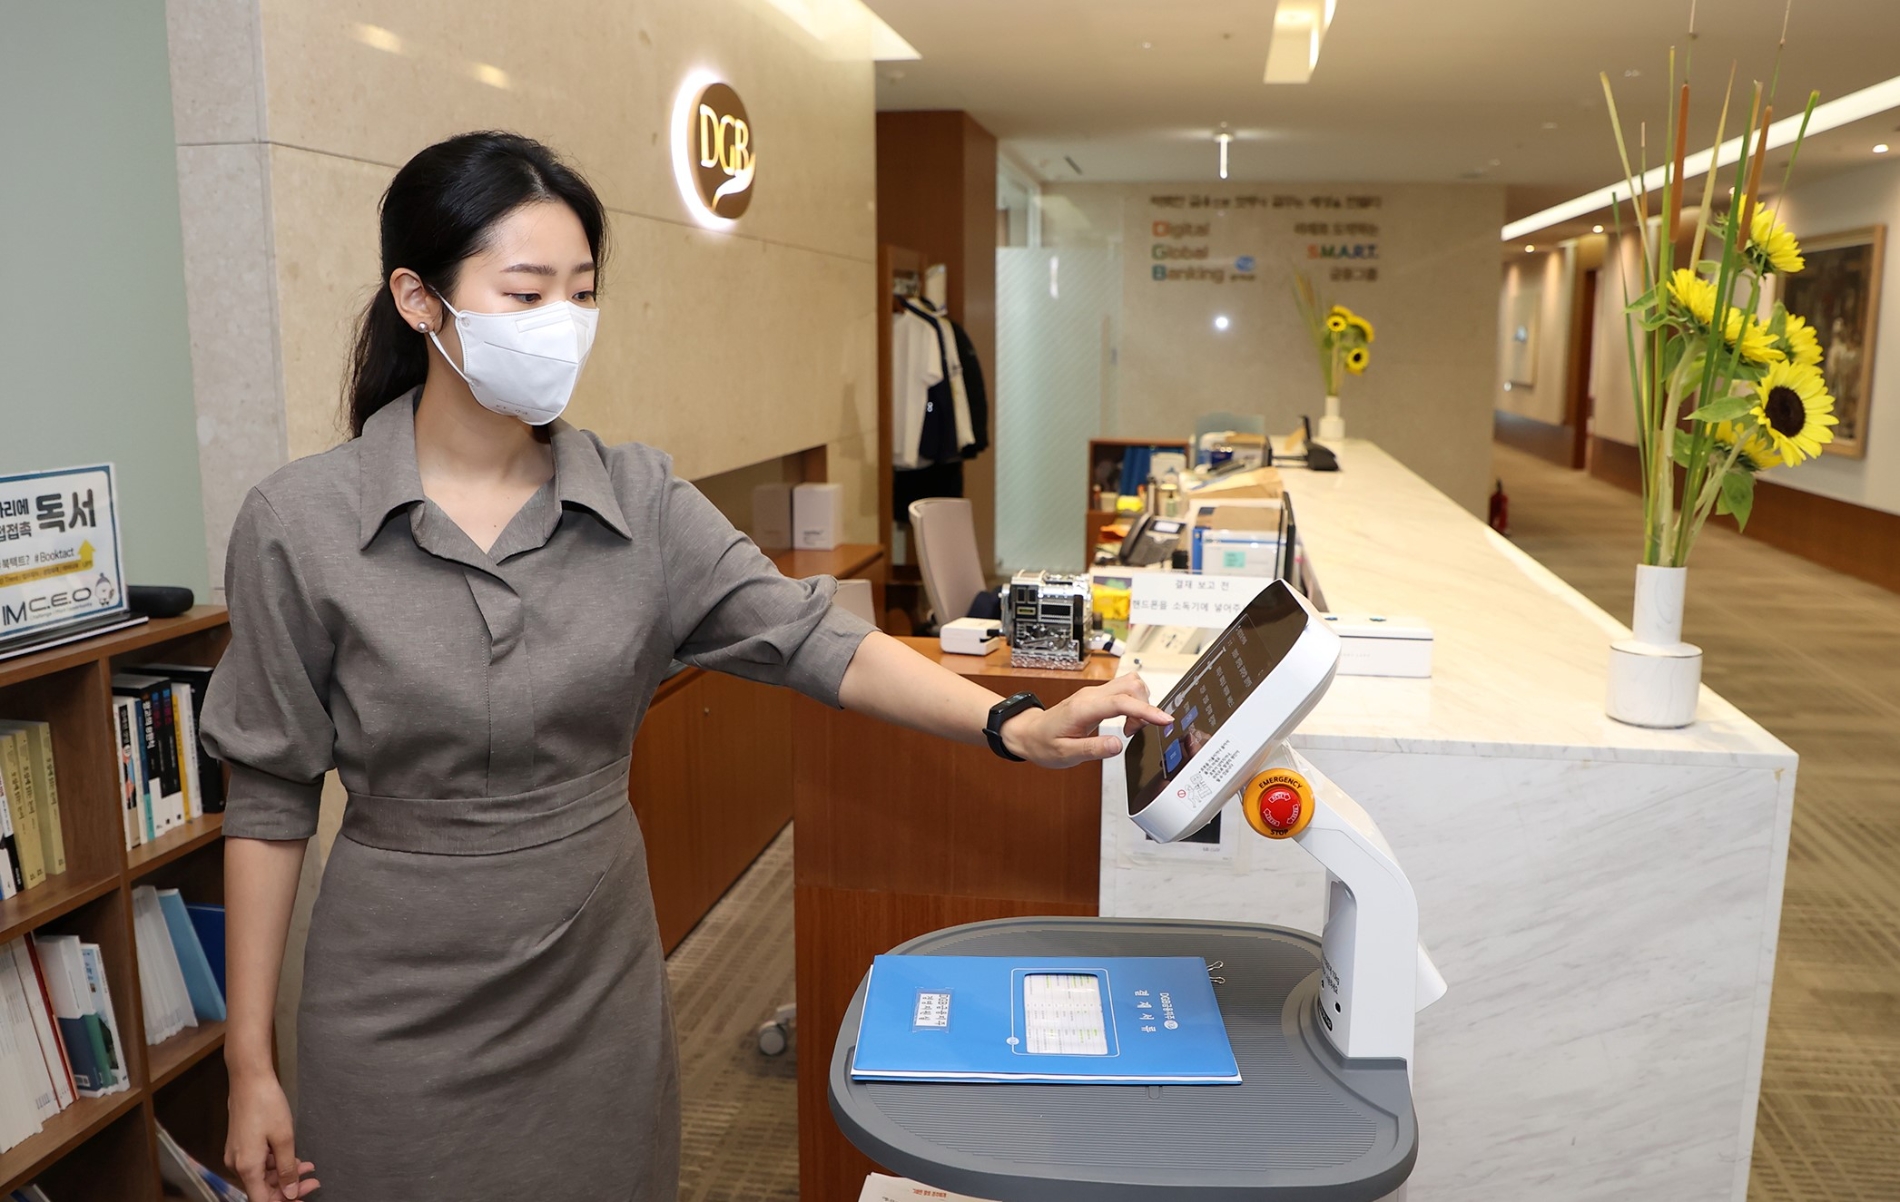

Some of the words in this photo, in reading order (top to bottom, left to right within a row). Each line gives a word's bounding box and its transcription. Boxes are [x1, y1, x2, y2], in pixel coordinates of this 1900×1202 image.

[700, 104, 750, 176] DGB
[1152, 265, 1224, 284] Banking
[36, 489, 97, 533] 독서
[34, 547, 75, 563] #Booktact
[1175, 580, 1194, 590] 결재
[1198, 580, 1215, 590] 보고
[1220, 580, 1230, 591] 전
[1172, 601, 1209, 612] 소독기에
[1258, 776, 1303, 789] EMERGENCY
